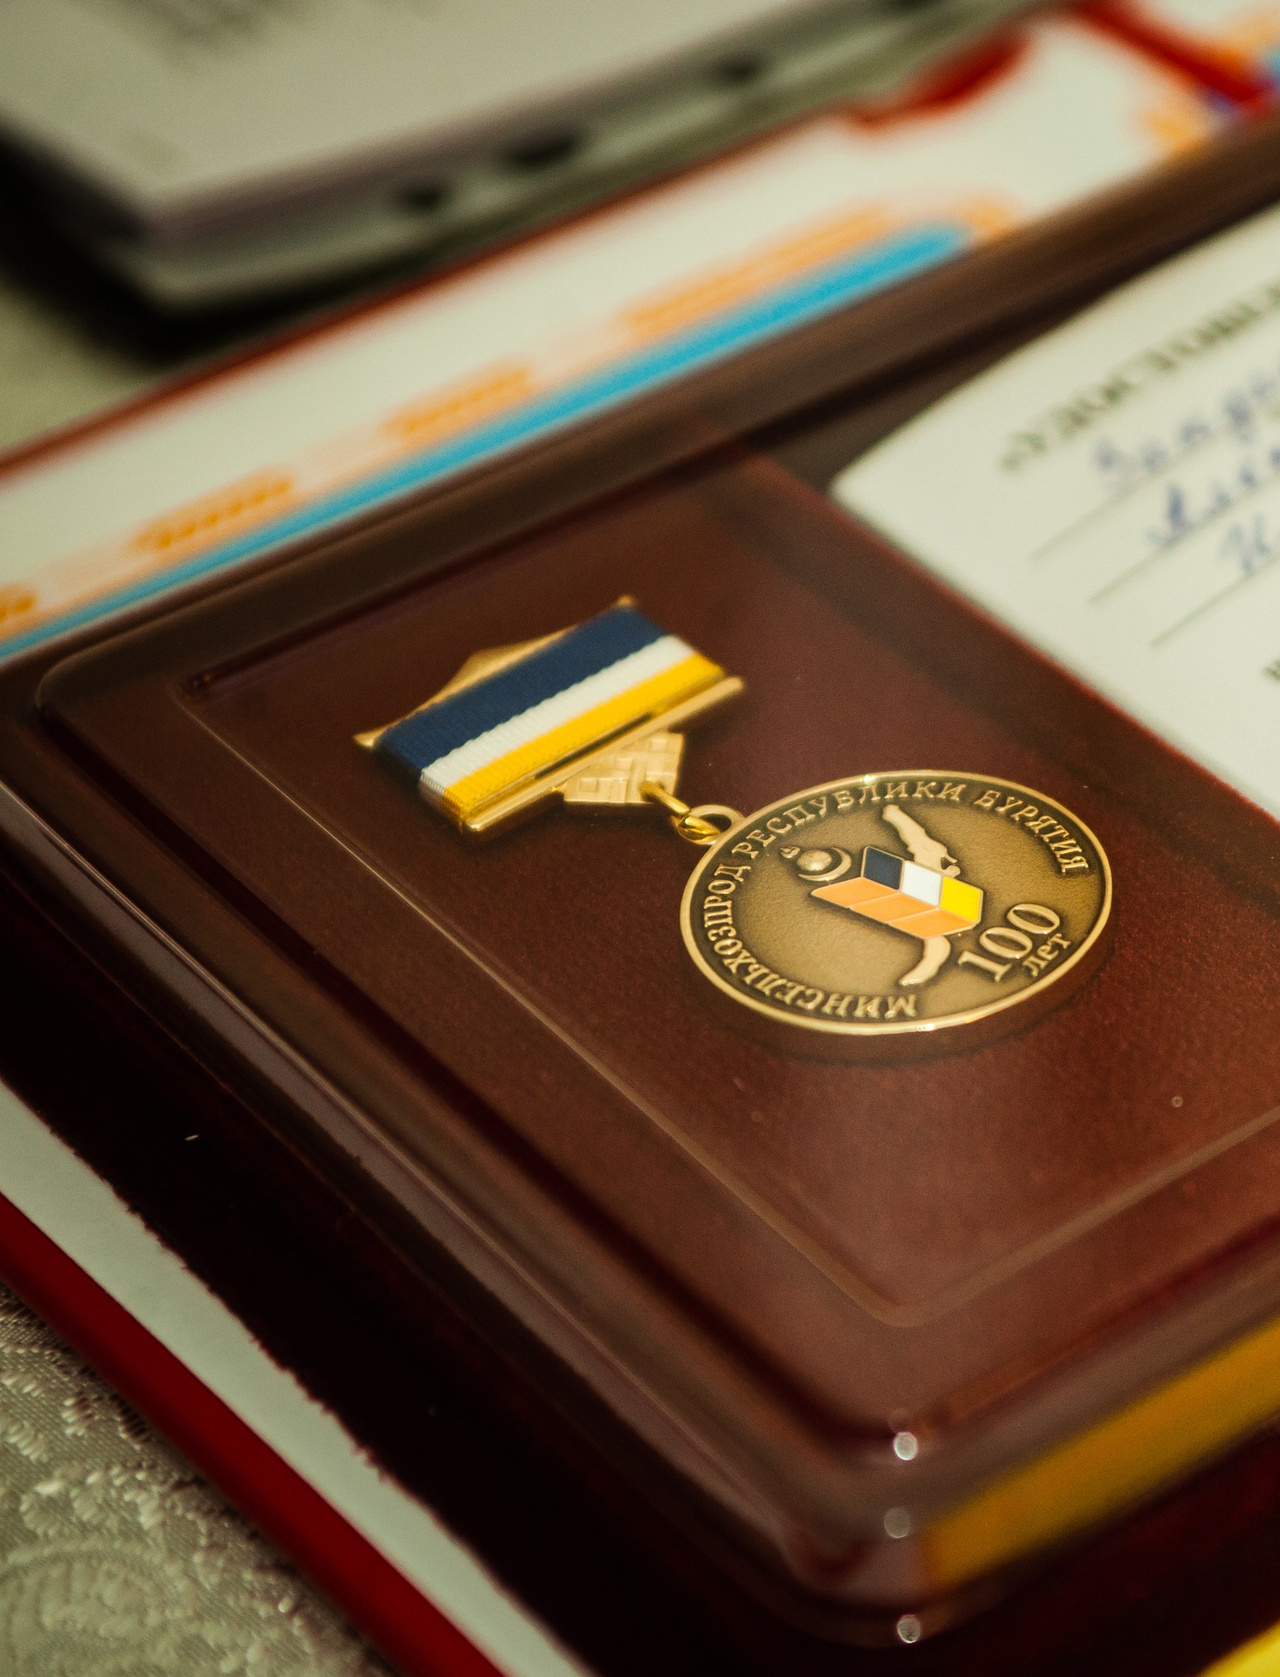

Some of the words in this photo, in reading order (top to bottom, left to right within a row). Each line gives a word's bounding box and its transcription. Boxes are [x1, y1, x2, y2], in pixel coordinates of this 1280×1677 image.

[733, 780, 966, 861] РЕСПУБЛИКИ
[974, 788, 1089, 874] БУРЯТИЯ
[703, 861, 918, 1019] МИНСЕЛЬХОЗПРОД
[958, 903, 1060, 982] 100
